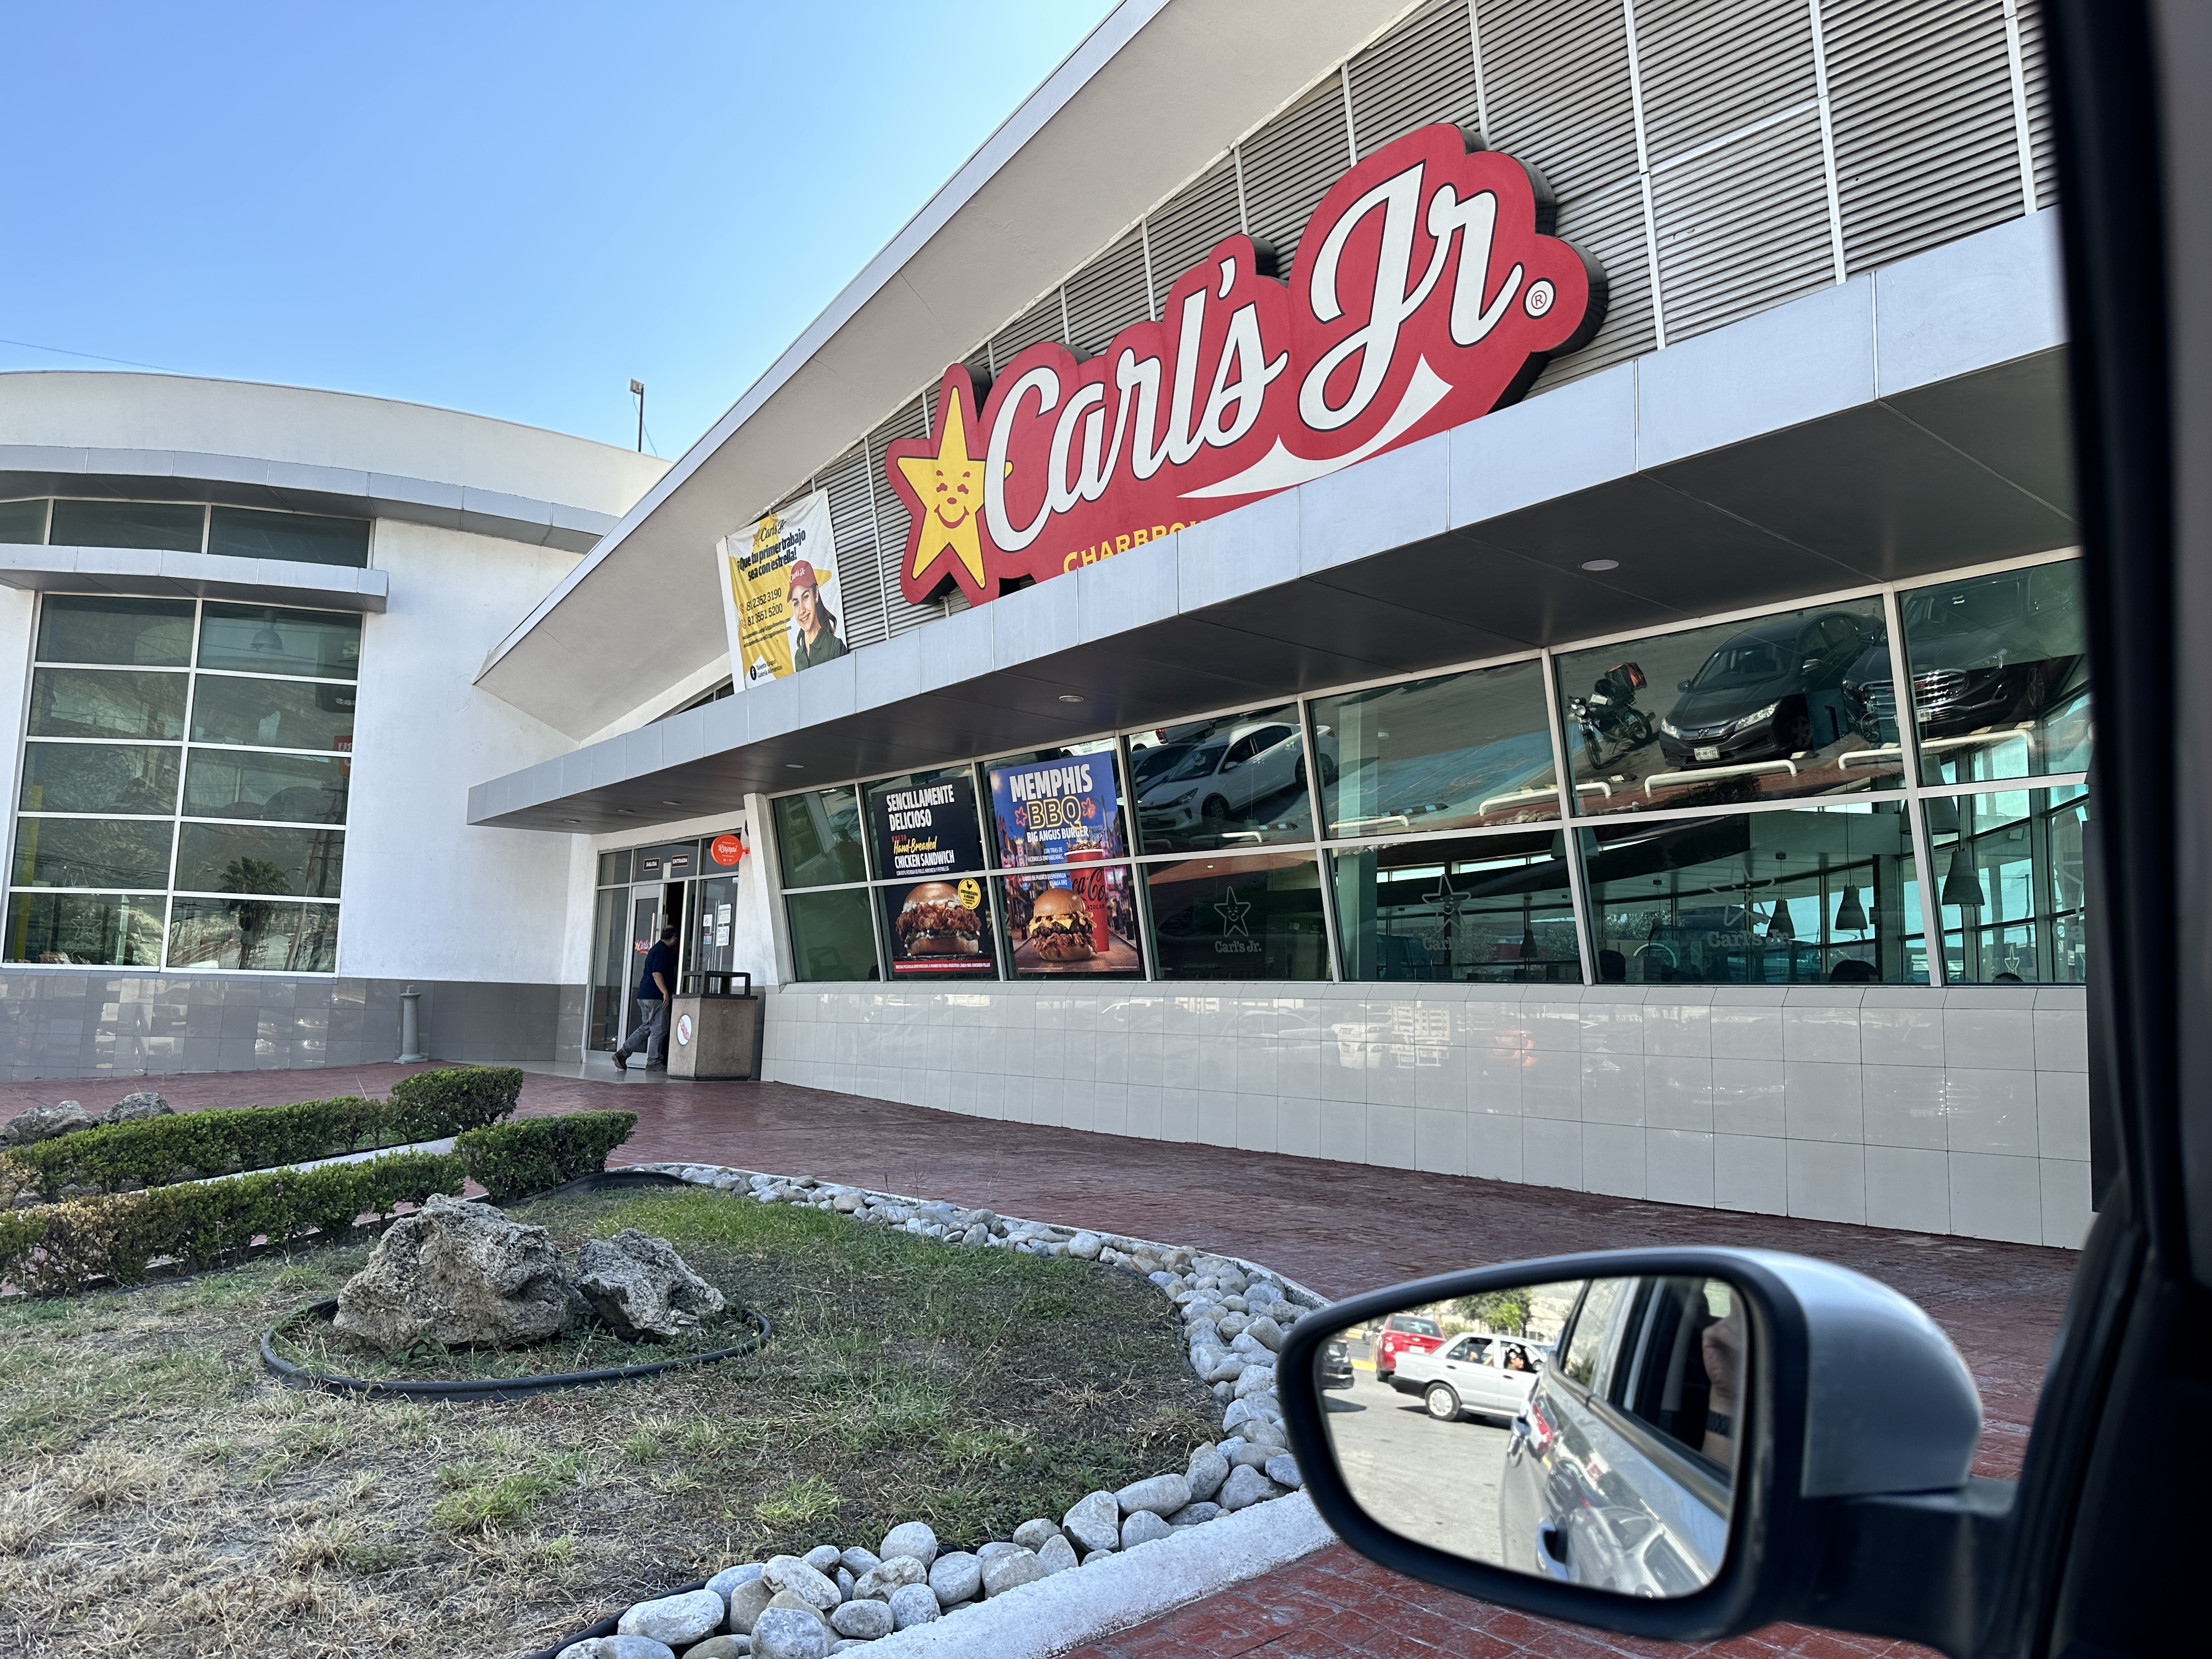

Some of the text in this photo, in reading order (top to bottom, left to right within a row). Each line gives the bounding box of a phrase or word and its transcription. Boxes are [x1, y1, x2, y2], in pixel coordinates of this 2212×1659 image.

[984, 255, 1288, 553] Carl's
[751, 551, 759, 565] tu
[759, 541, 781, 565] primer
[781, 528, 806, 551] trabajo
[748, 546, 797, 582] sea con estrella!
[746, 587, 782, 611] 81 2352 3190
[747, 603, 783, 627] 81 3551 5200
[1009, 764, 1093, 802] MEMPHIS
[886, 784, 955, 812] SENCILLAMENTE
[888, 808, 933, 832] DELICIOSO
[1026, 795, 1081, 830] BBQ
[893, 835, 938, 855] Hand-Breaded
[1026, 826, 1090, 843] BIG ANGUS BURGER
[718, 844, 738, 854] Rappi
[894, 849, 955, 869] CHICKEN SANDWICH
[1215, 940, 1262, 953] Carl's Jr.
[1707, 929, 1793, 948] Carl's Jr.
